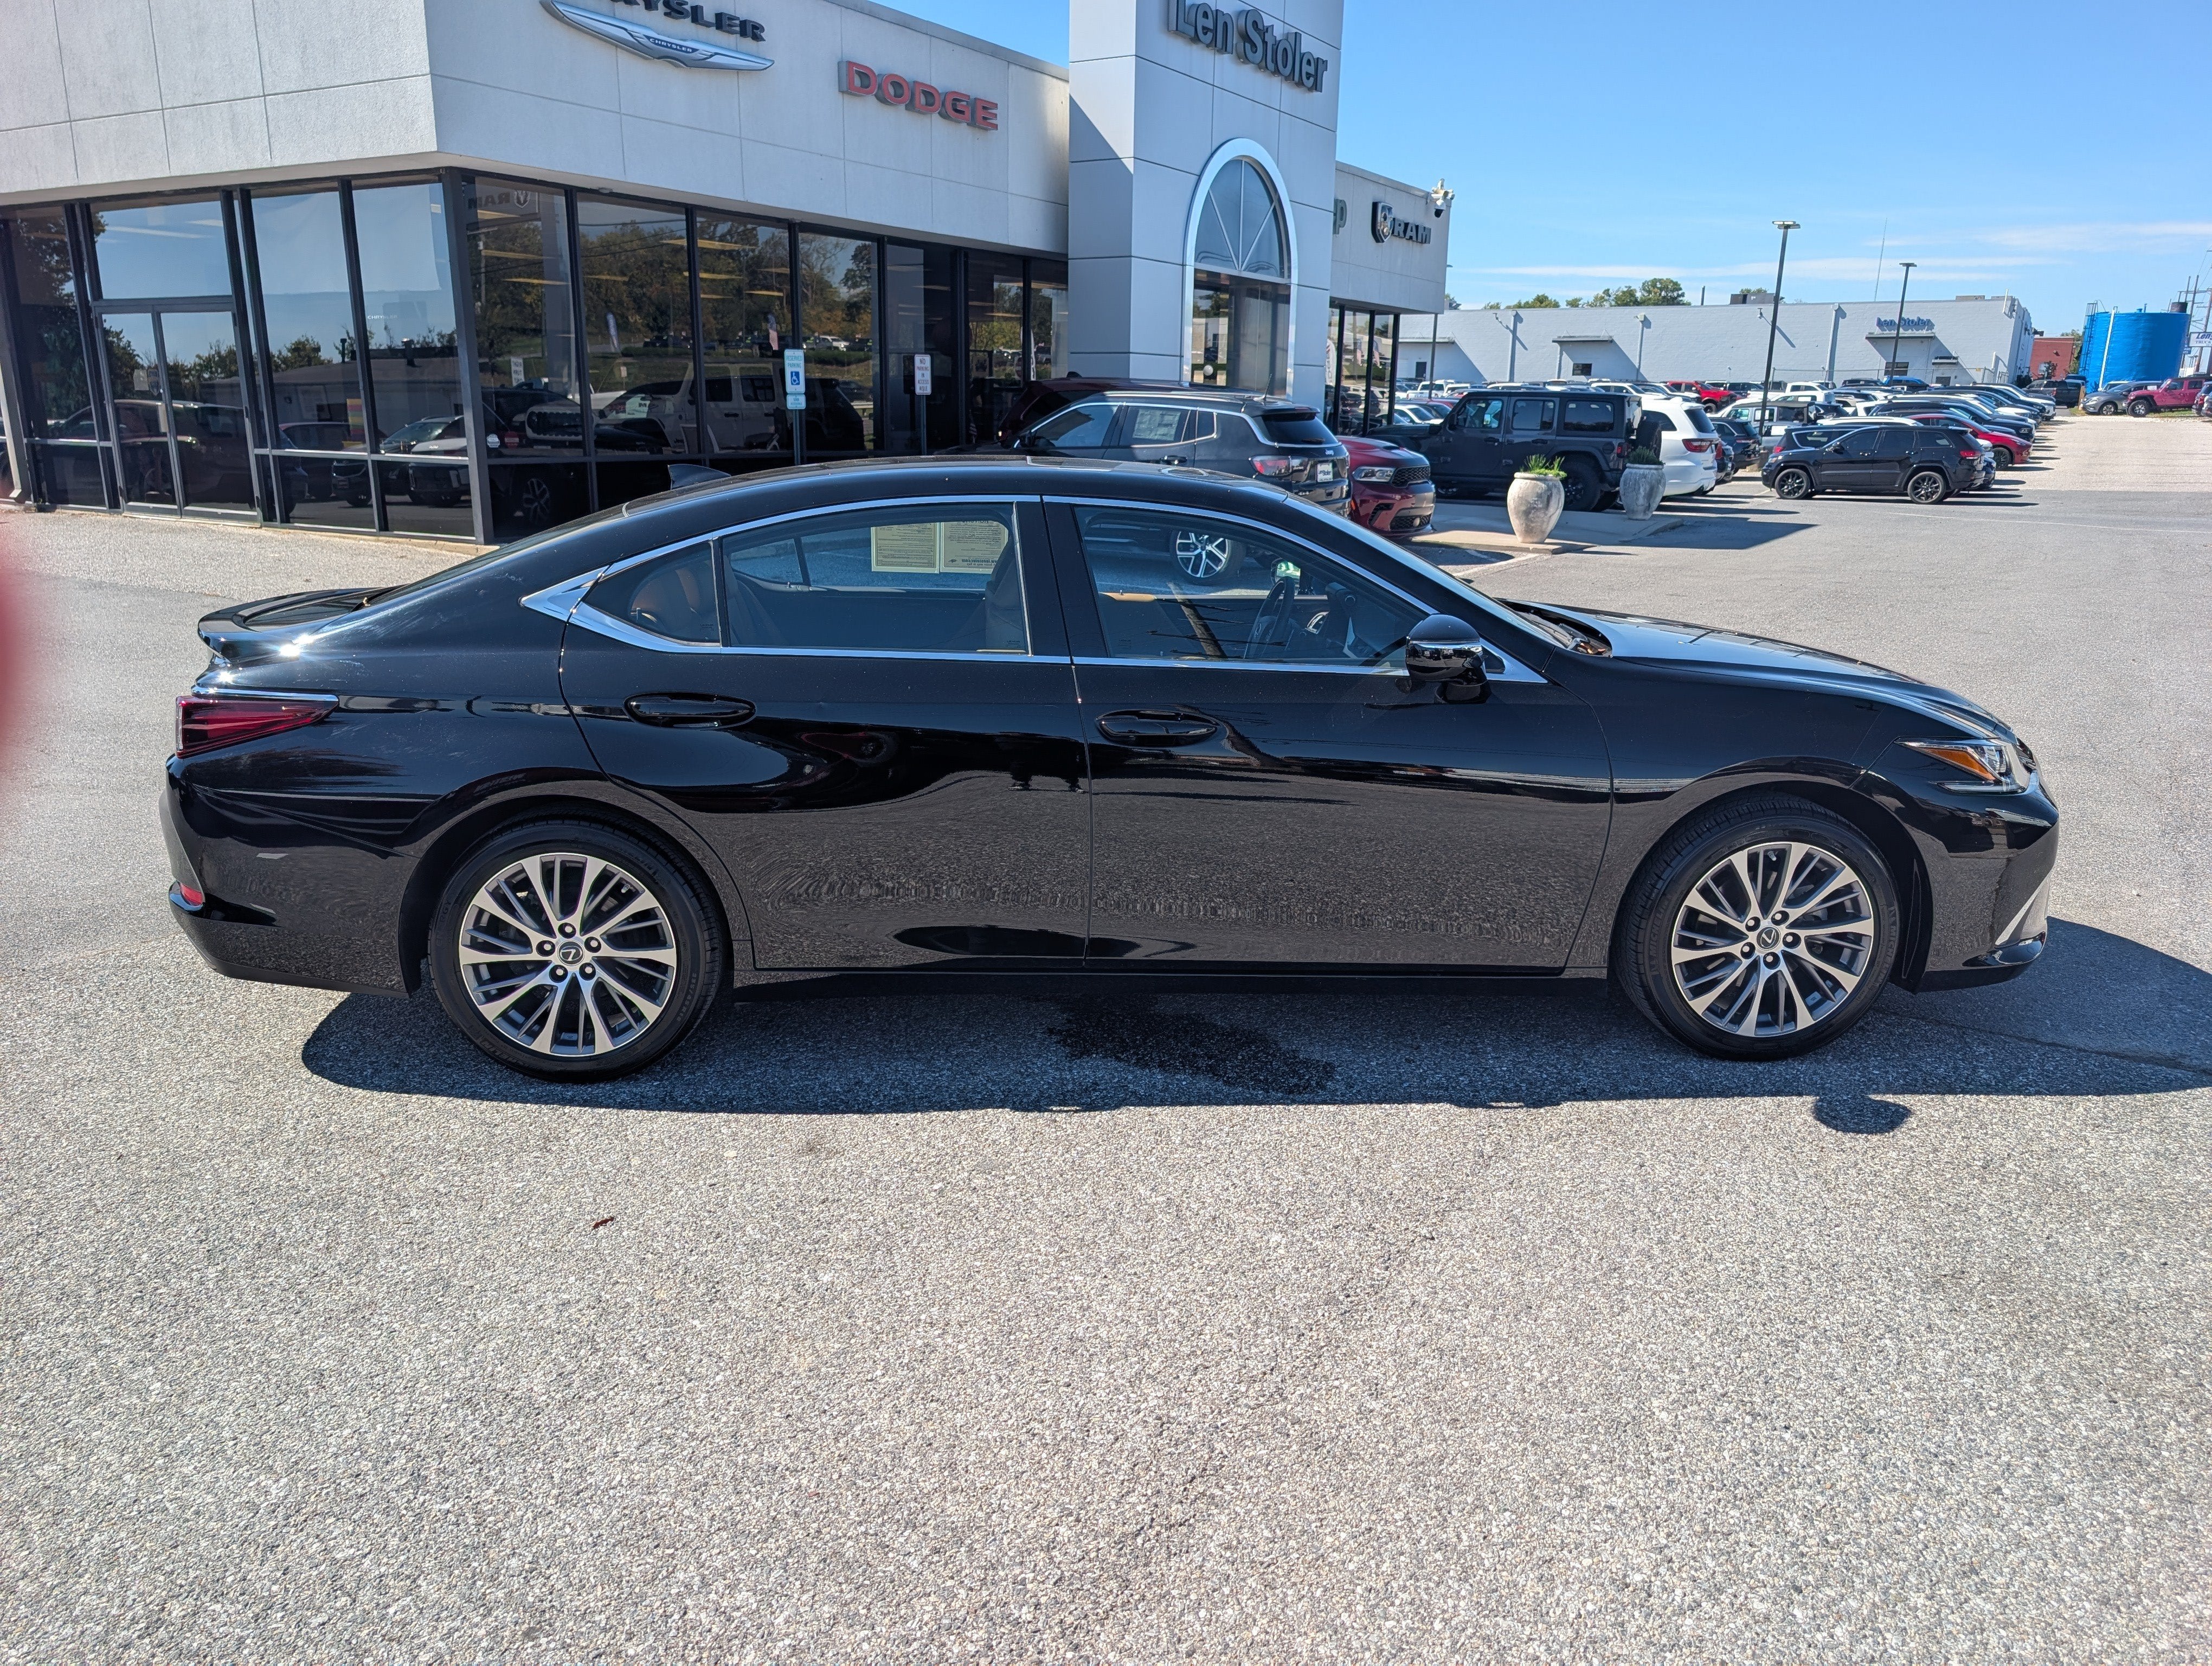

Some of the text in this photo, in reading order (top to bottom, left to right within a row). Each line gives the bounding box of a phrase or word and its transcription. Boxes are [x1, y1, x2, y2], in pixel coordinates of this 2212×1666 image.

[650, 37, 692, 53] CHRYSLER
[1167, 0, 1328, 92] Len Stoler
[838, 61, 998, 131] DODGE
[1392, 217, 1431, 244] RAM
[1876, 317, 1894, 326] Len
